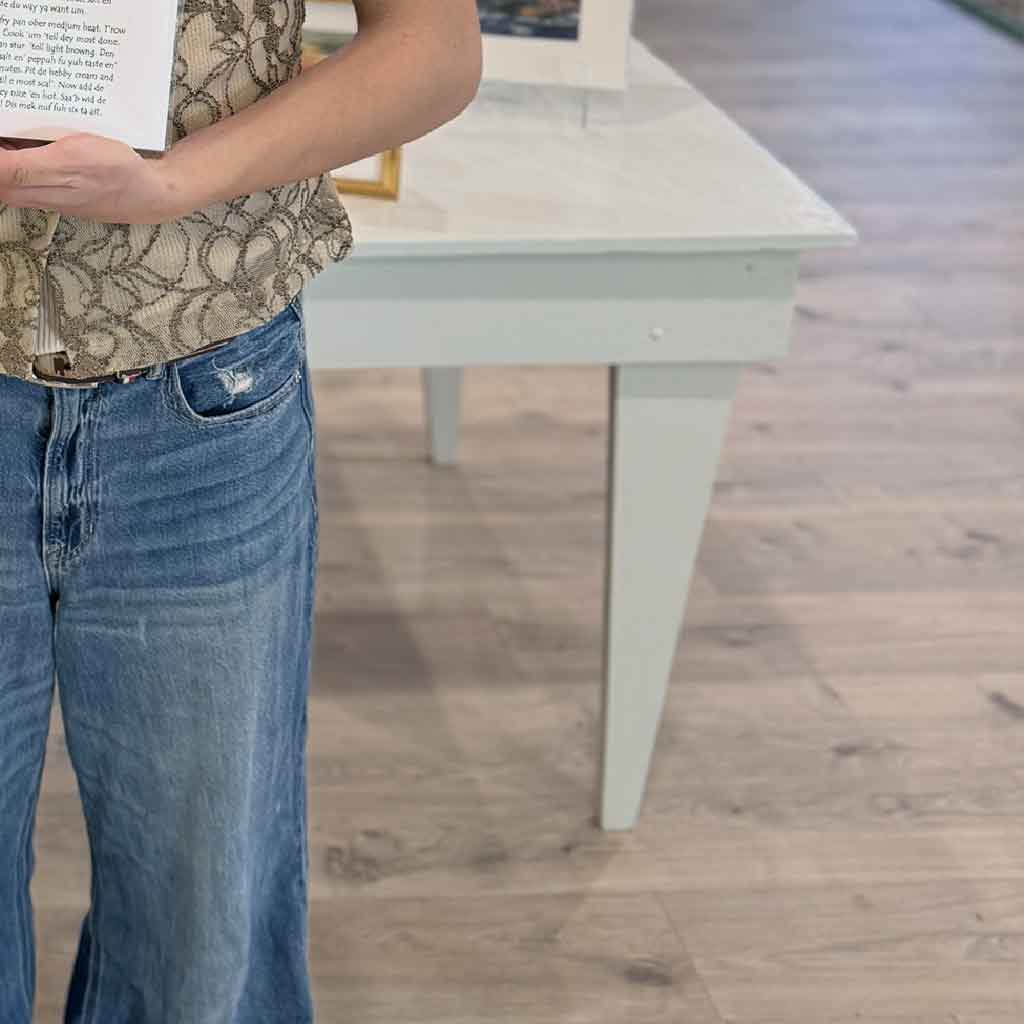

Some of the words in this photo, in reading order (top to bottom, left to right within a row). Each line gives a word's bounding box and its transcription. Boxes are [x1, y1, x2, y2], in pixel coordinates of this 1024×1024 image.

[22, 3, 38, 12] way
[39, 4, 48, 13] ya
[49, 3, 69, 12] want
[0, 15, 10, 26] fry
[12, 18, 26, 27] pan
[2, 28, 24, 37] Cook
[99, 48, 115, 56] Den
[85, 59, 103, 67] taste
[100, 71, 114, 80] and
[57, 80, 77, 89] Now
[78, 82, 93, 90] add
[93, 83, 104, 91] de
[96, 95, 107, 103] de
